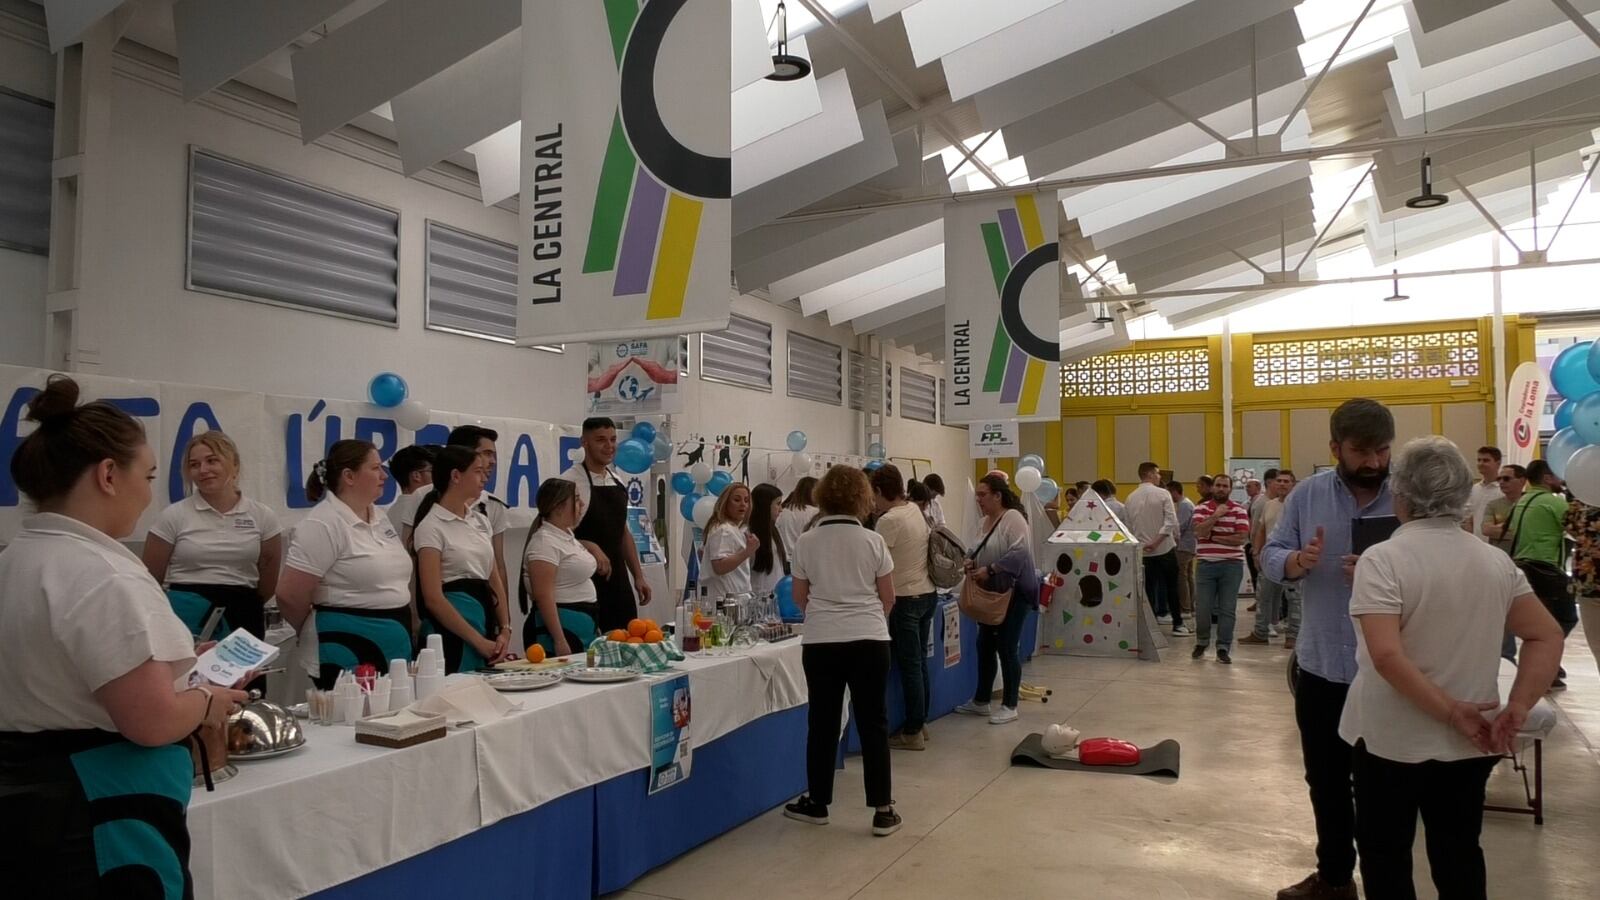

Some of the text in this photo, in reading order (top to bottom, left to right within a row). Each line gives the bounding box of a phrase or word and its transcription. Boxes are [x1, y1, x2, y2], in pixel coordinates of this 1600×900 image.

[532, 122, 563, 305] LA CENTRAL
[630, 342, 648, 350] SAFA
[954, 320, 970, 405] LA CENTRAL
[1524, 381, 1539, 418] la Loma
[980, 431, 1002, 442] FP
